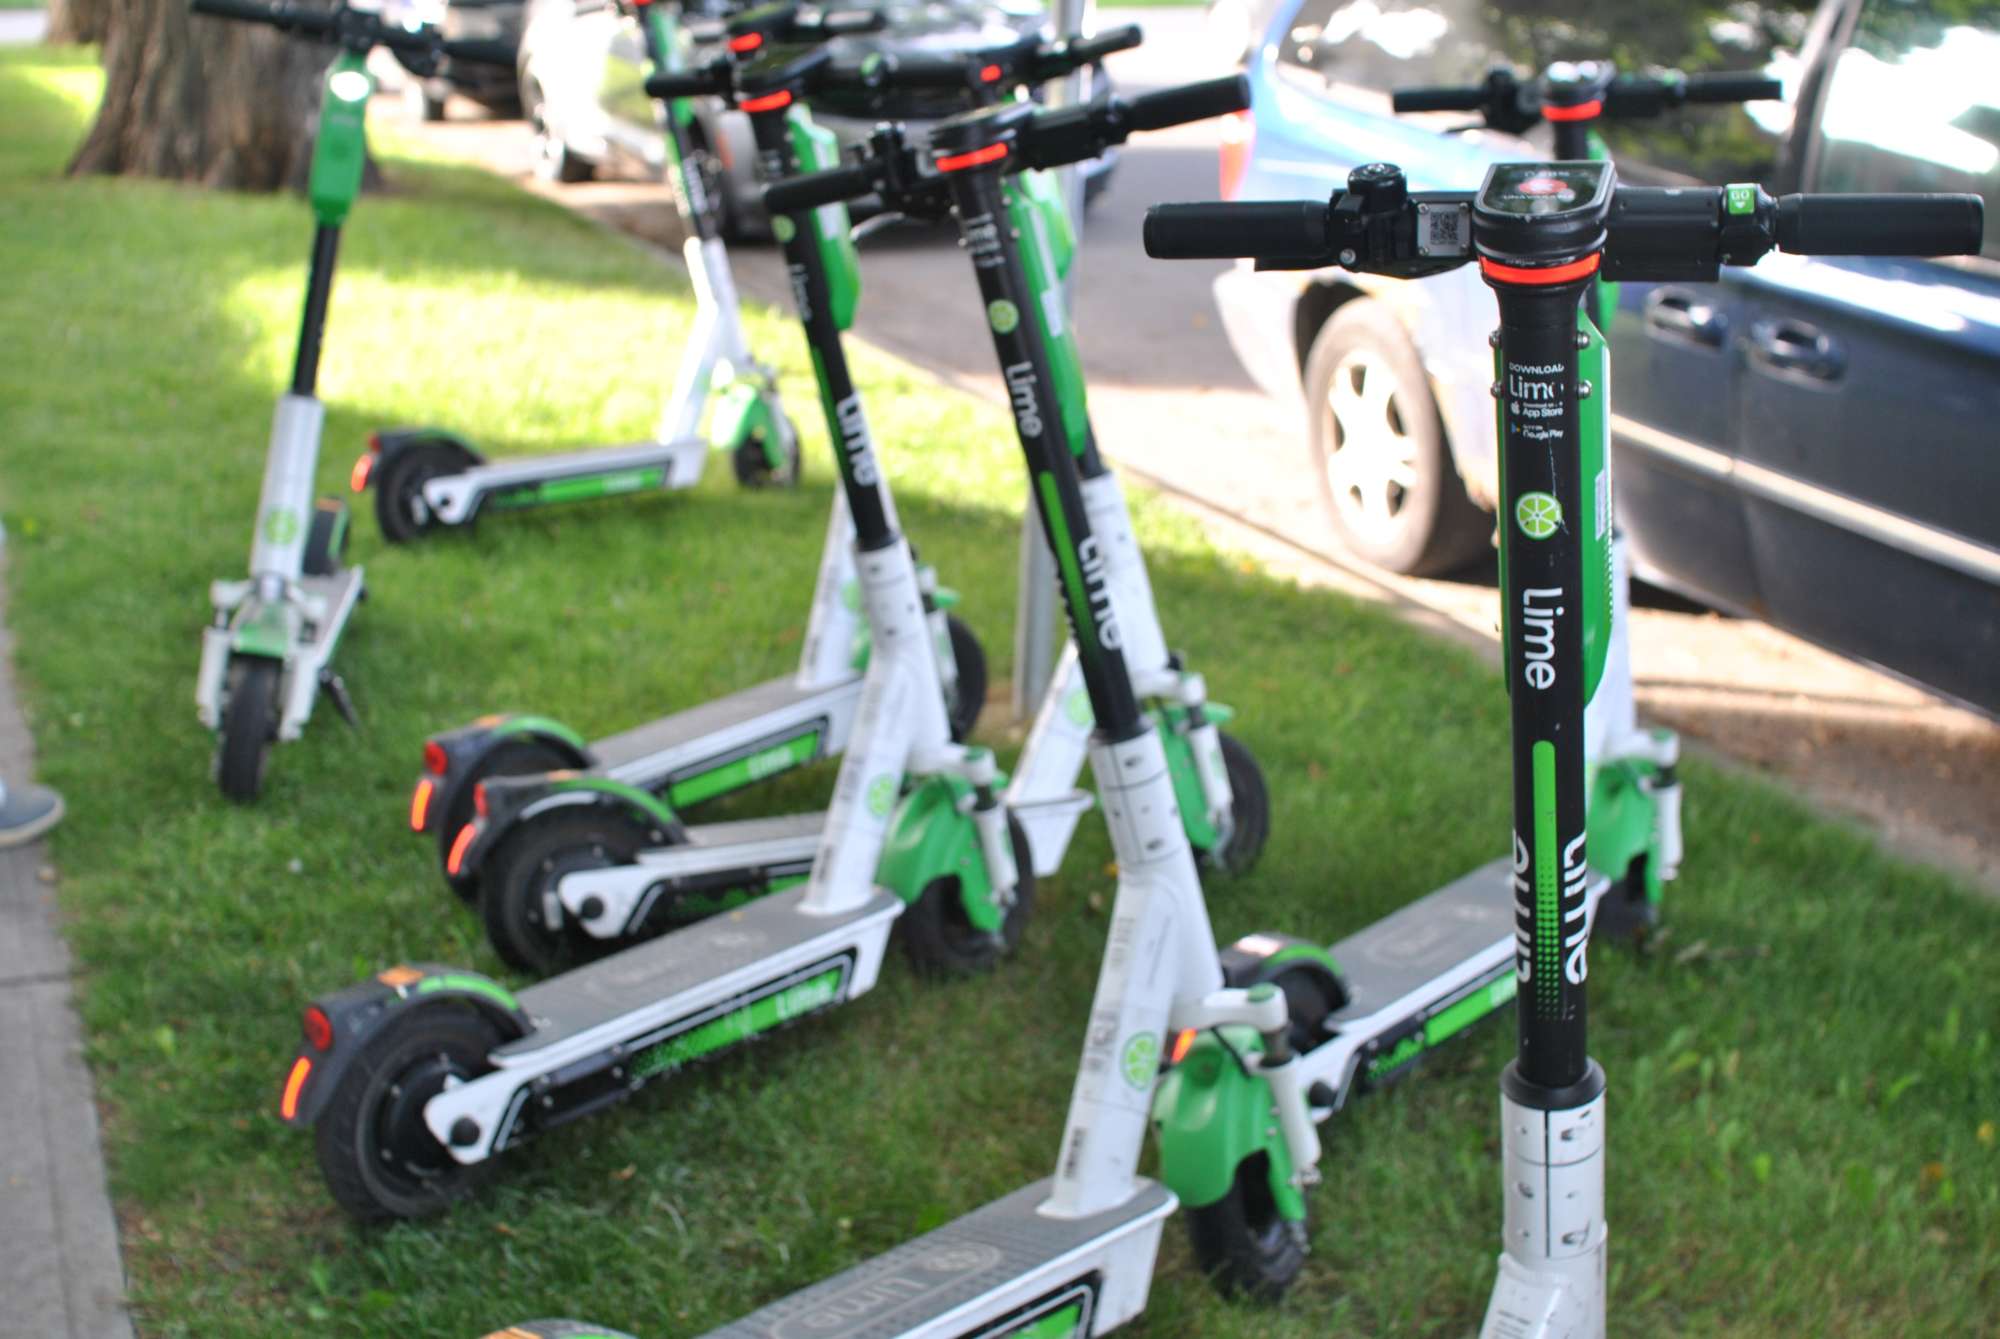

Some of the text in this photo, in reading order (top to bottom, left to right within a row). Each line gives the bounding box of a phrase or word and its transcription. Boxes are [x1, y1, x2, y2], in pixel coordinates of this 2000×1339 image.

[1731, 190, 1750, 200] GO
[1509, 362, 1565, 375] DOWNLOAD
[1005, 361, 1043, 438] Lime
[1523, 407, 1564, 418] App Store
[1523, 587, 1564, 690] Lime
